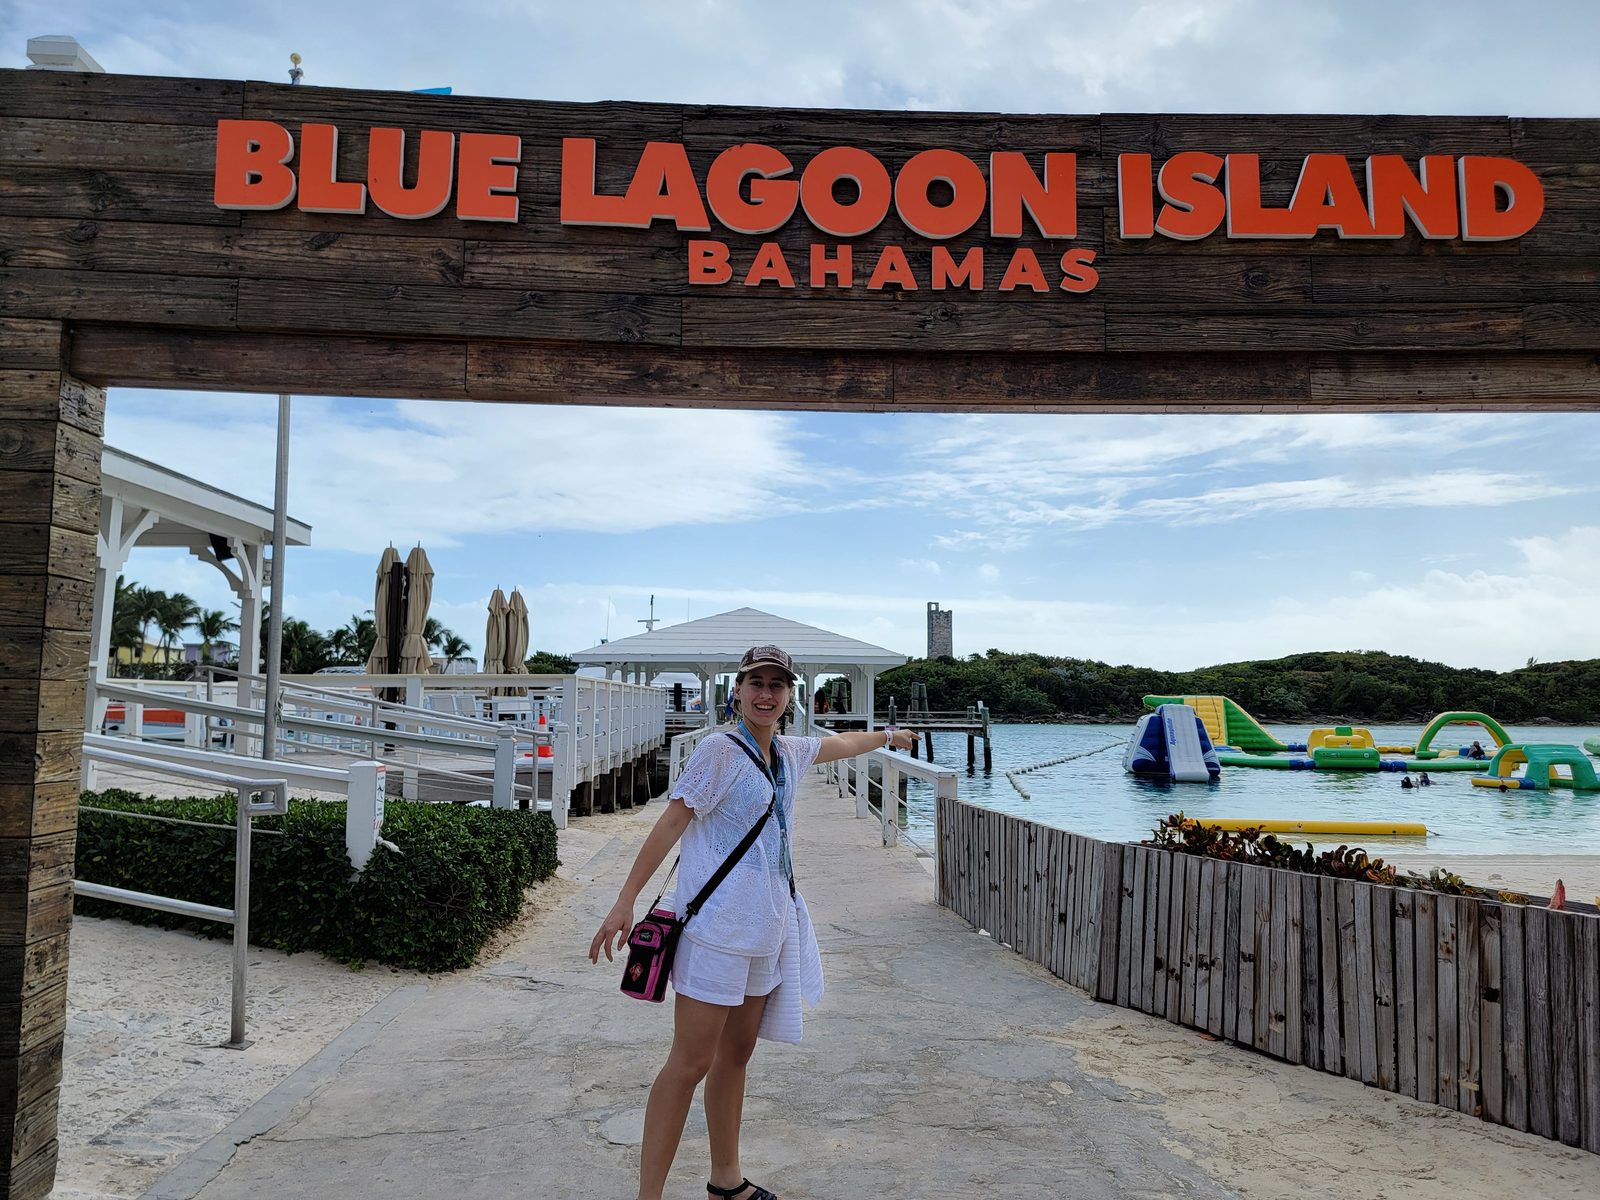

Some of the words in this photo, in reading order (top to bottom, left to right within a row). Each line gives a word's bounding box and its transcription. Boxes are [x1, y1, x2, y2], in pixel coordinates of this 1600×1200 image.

[214, 119, 521, 223] BLUE
[560, 137, 1078, 239] LAGOON
[1117, 151, 1545, 242] ISLAND
[688, 239, 1099, 294] BAHAMAS
